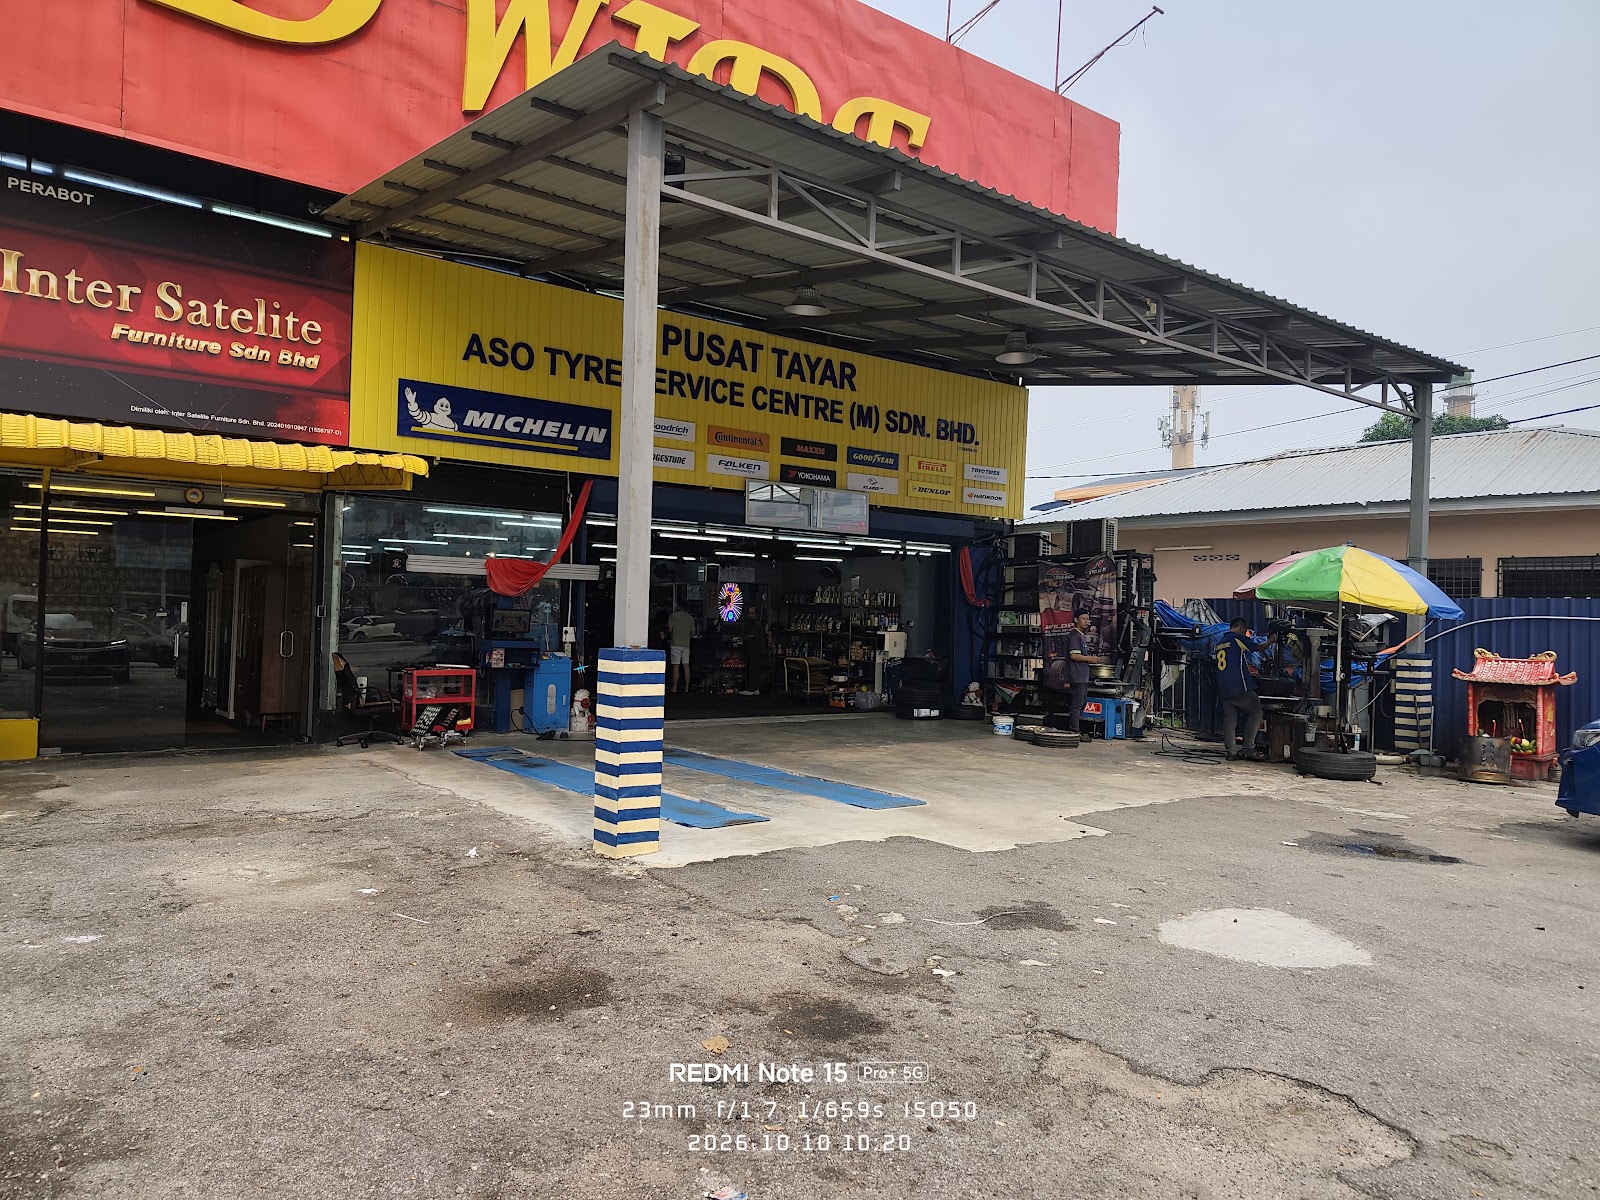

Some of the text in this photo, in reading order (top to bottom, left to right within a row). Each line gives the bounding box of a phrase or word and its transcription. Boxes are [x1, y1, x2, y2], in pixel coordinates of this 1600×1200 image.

[7, 176, 94, 206] PERABOT
[0, 248, 322, 345] Inter Satelite
[111, 322, 321, 369] Furniture Sdn Bhd
[662, 324, 857, 392] PUSAT TAYAR
[462, 333, 980, 446] ASO TYRE ERVICE CENTRE (M) SDN. BHD.
[171, 410, 186, 418] Inter
[462, 409, 608, 444] MICHELIN
[653, 422, 689, 434] oodrich
[714, 431, 757, 446] Continental
[796, 444, 826, 456] MAXXIS
[653, 453, 687, 465] DGESTONE
[718, 459, 761, 471] FALKEN
[852, 452, 895, 465] GOODYEAR
[918, 461, 947, 473] PIRELLI
[797, 472, 831, 482] YOKOHAMA
[917, 486, 951, 496] DUNLOP
[1217, 649, 1227, 671] 8
